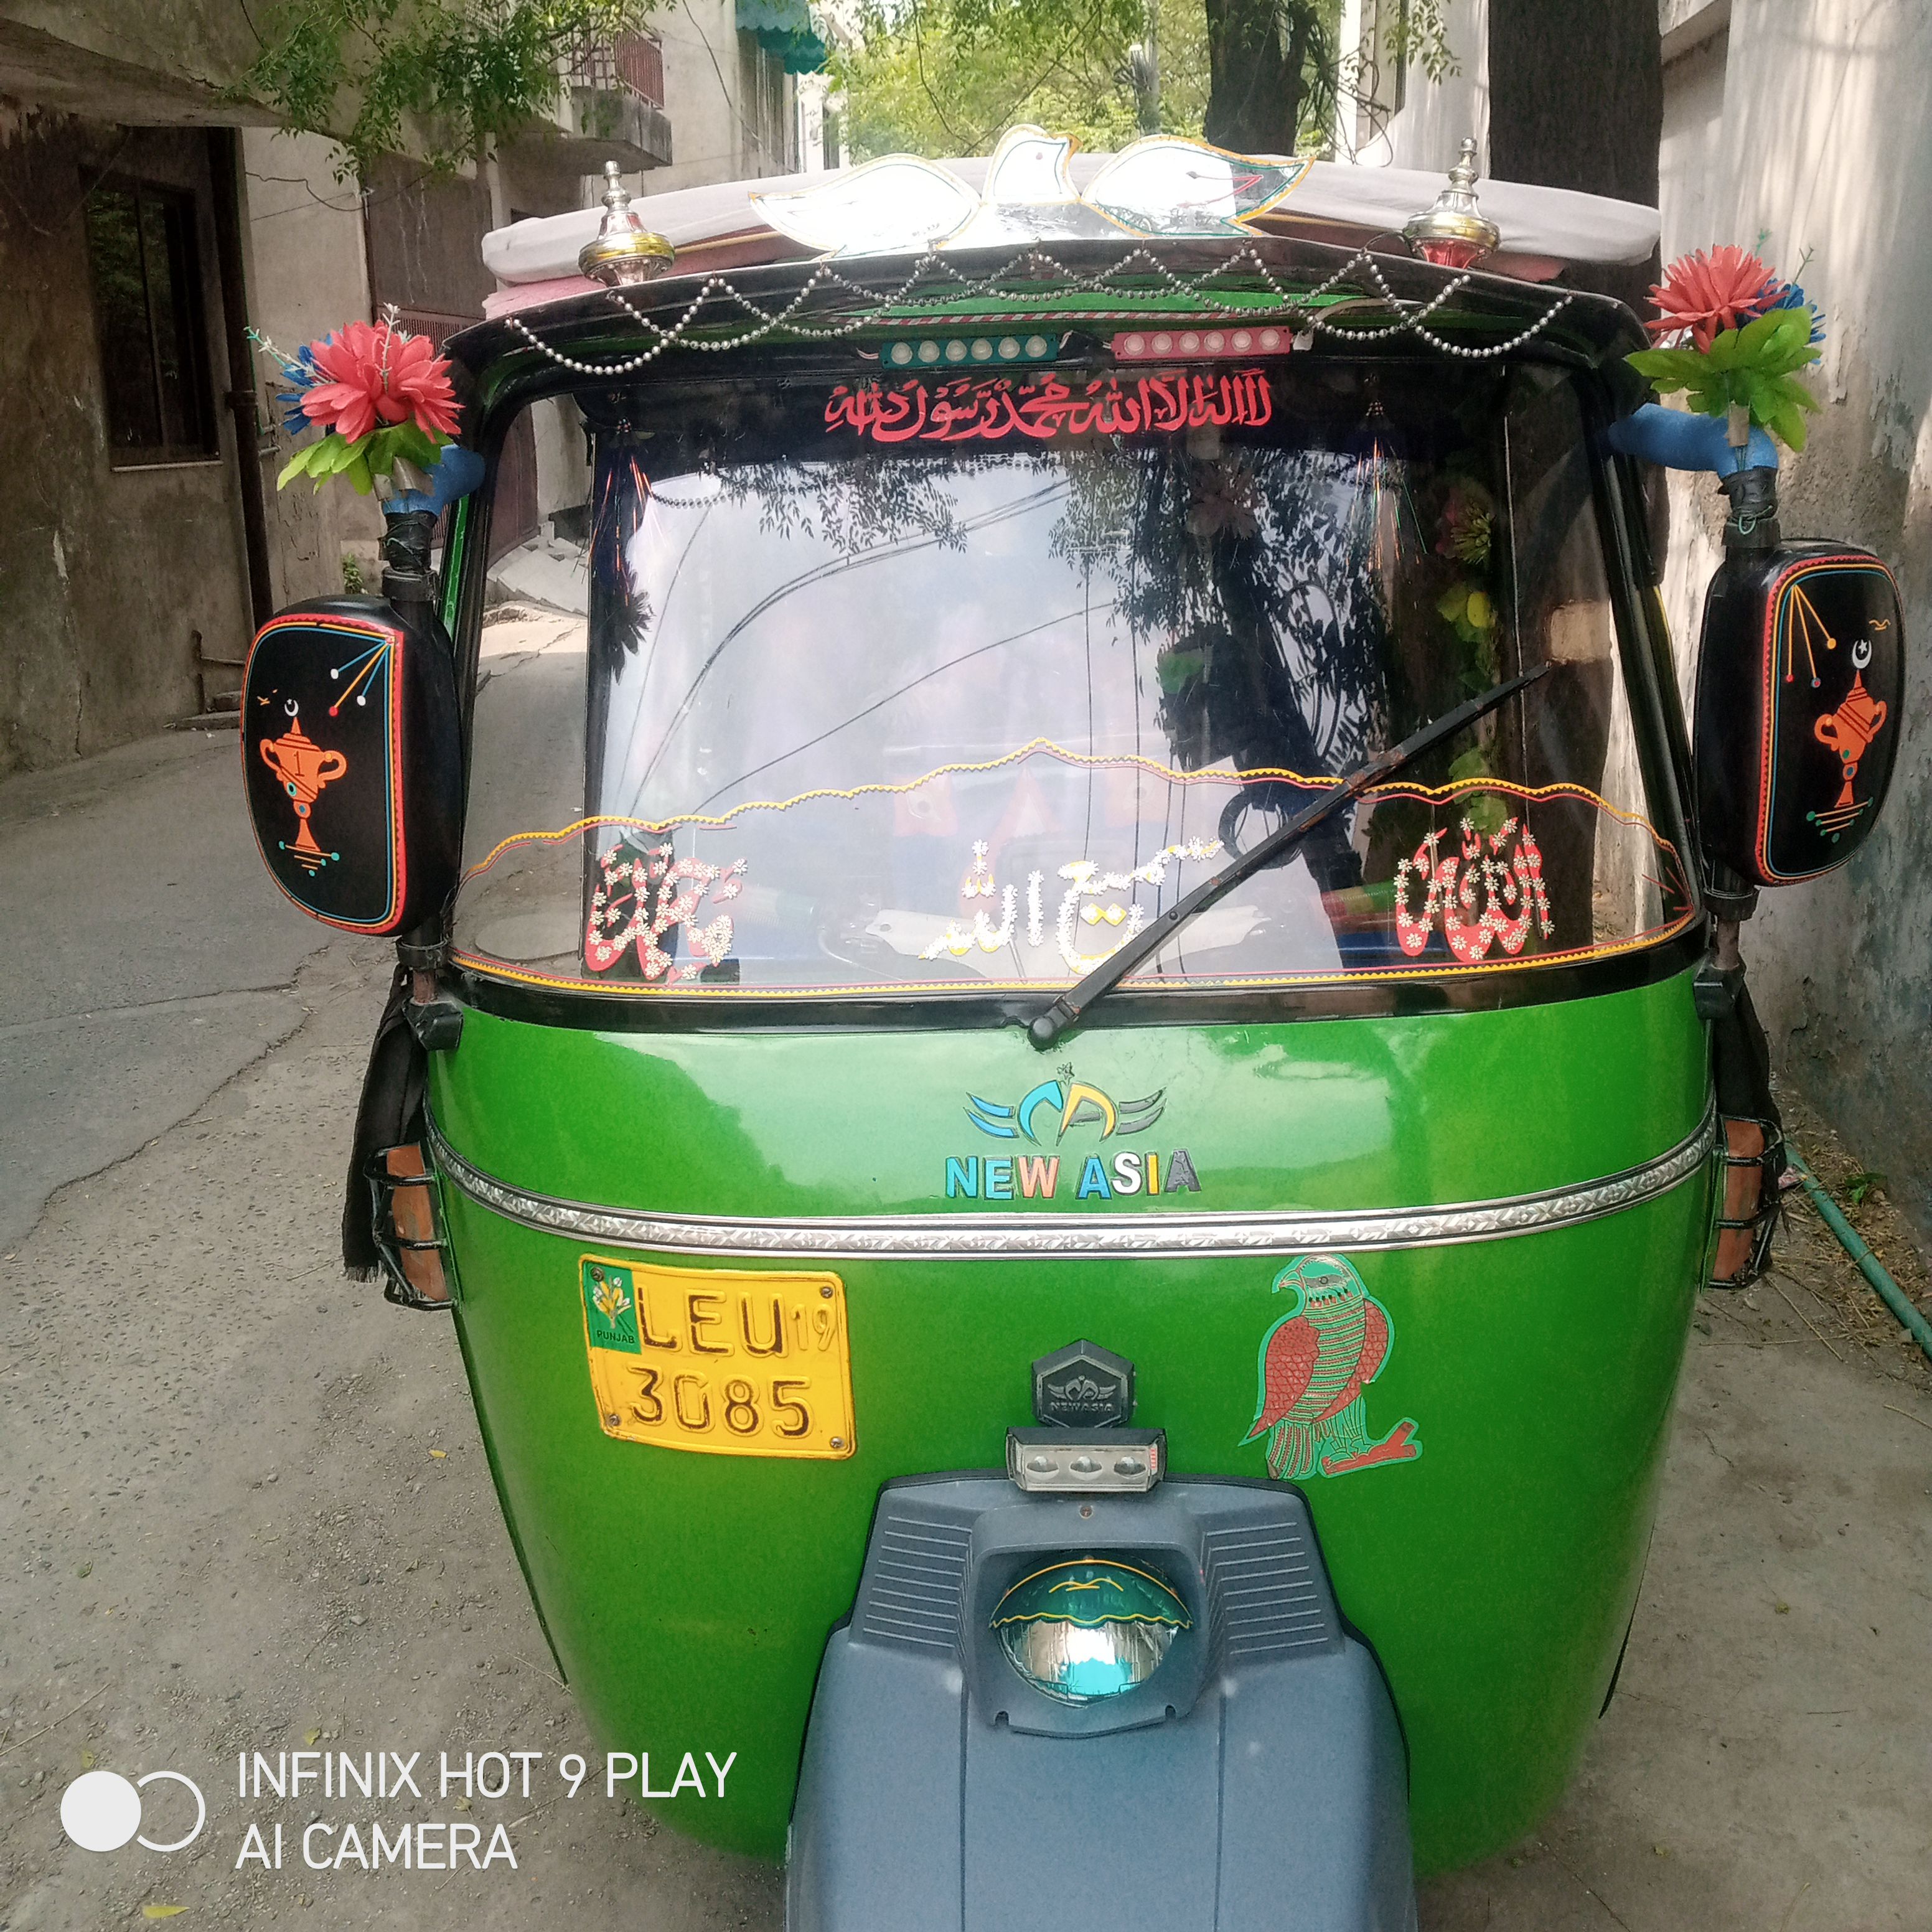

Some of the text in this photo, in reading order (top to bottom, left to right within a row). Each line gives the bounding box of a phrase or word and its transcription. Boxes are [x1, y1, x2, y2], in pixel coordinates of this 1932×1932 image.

[945, 1148, 1202, 1200] NEW ASIA
[596, 1328, 635, 1344] PUNJAB
[637, 1285, 789, 1358] LEU
[625, 1362, 815, 1440] 3085
